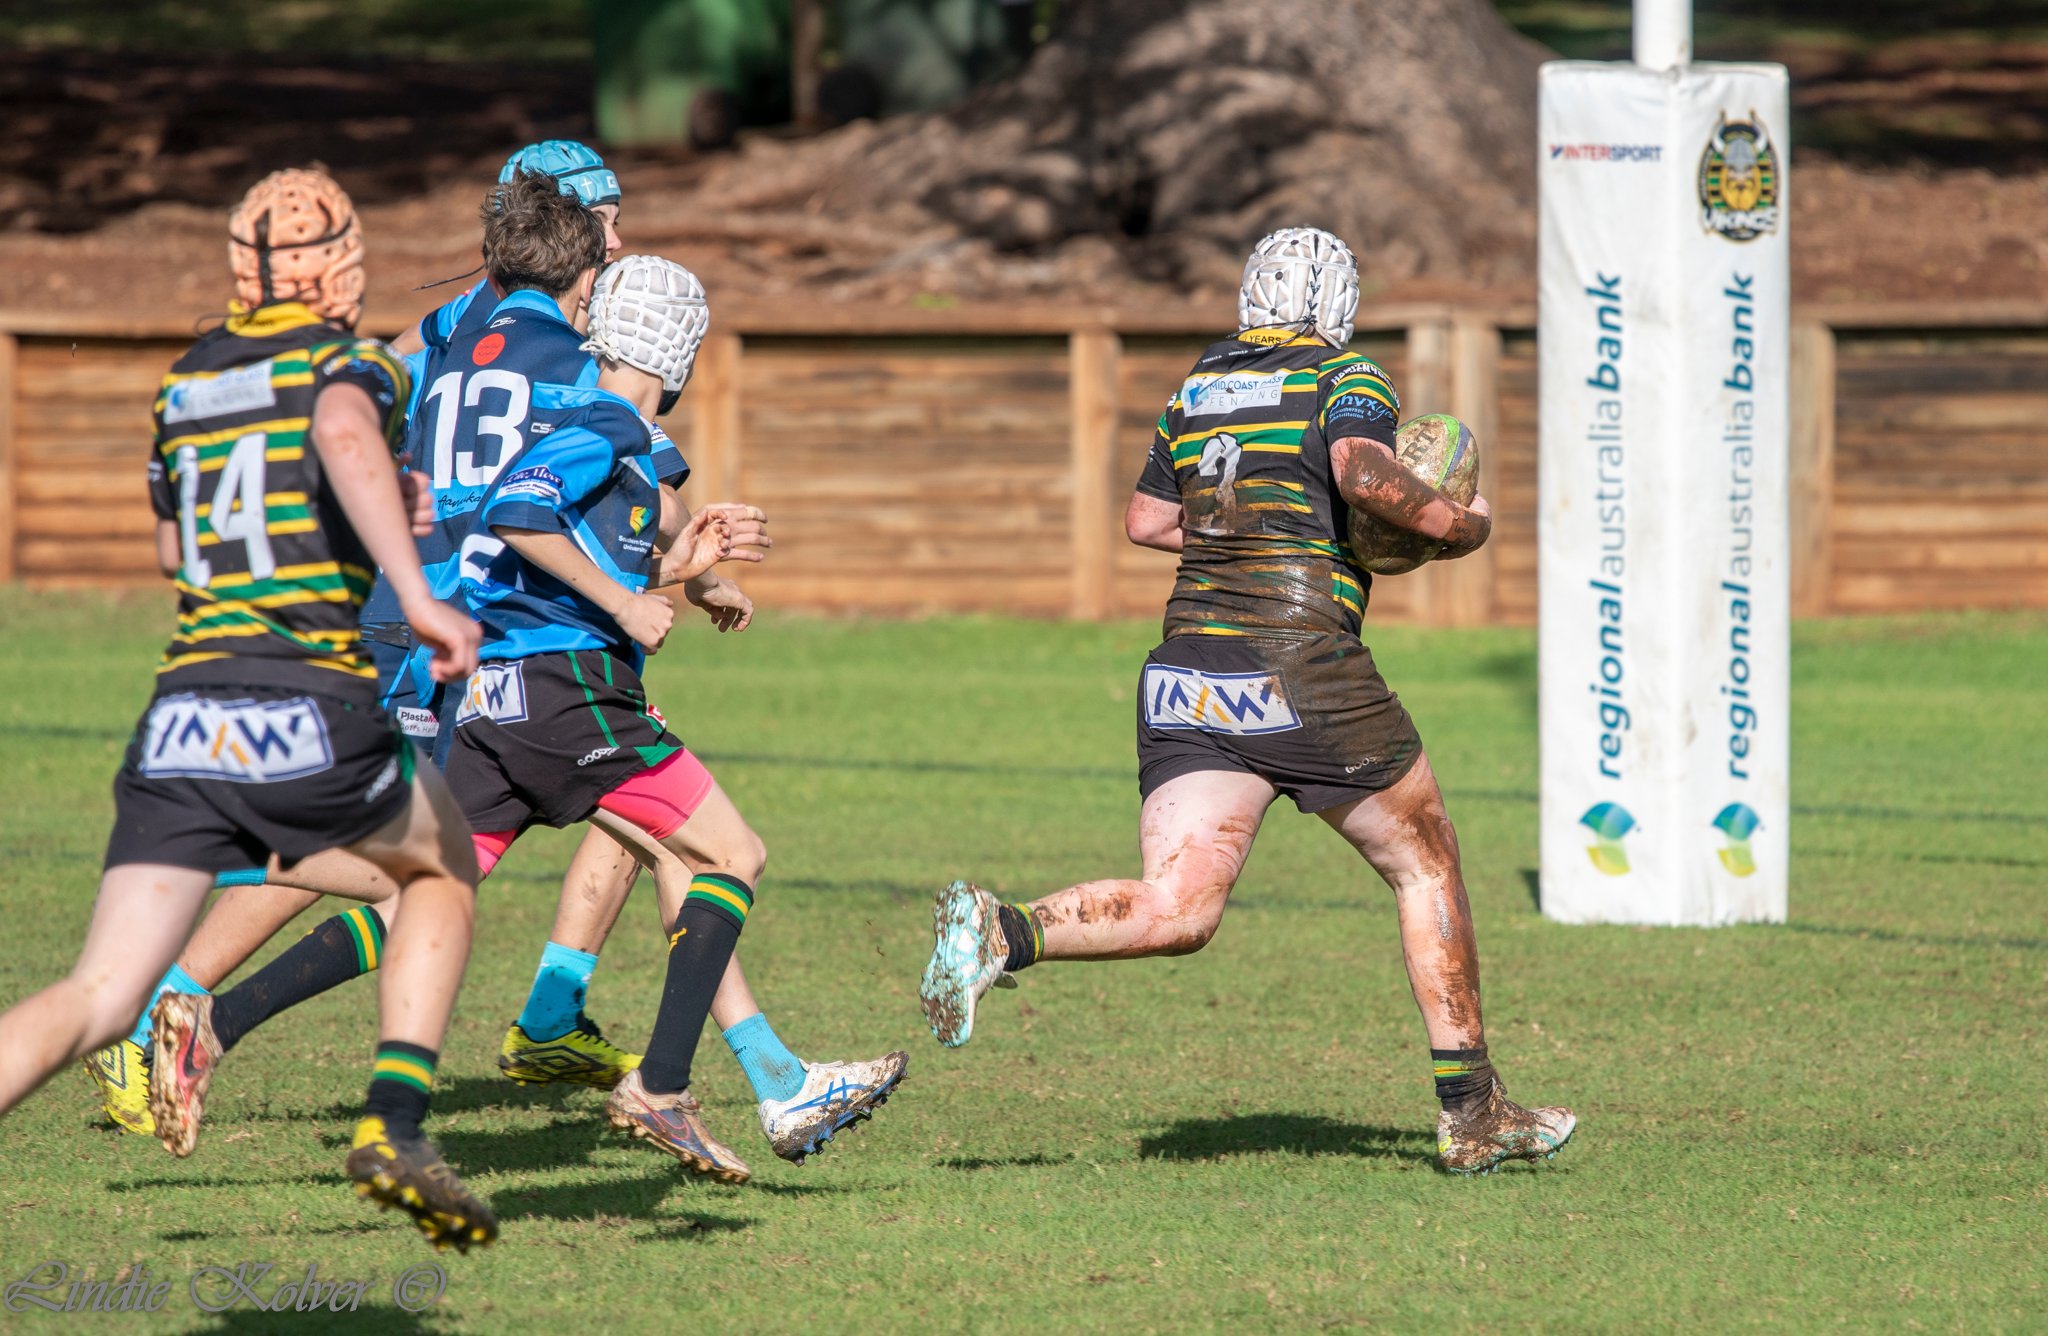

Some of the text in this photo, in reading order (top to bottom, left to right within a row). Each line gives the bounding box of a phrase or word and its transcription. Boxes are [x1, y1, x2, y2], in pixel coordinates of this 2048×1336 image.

[1564, 145, 1662, 161] INTERSPORT
[1249, 336, 1282, 344] YEARS
[425, 369, 530, 489] 13
[176, 431, 276, 589] 14
